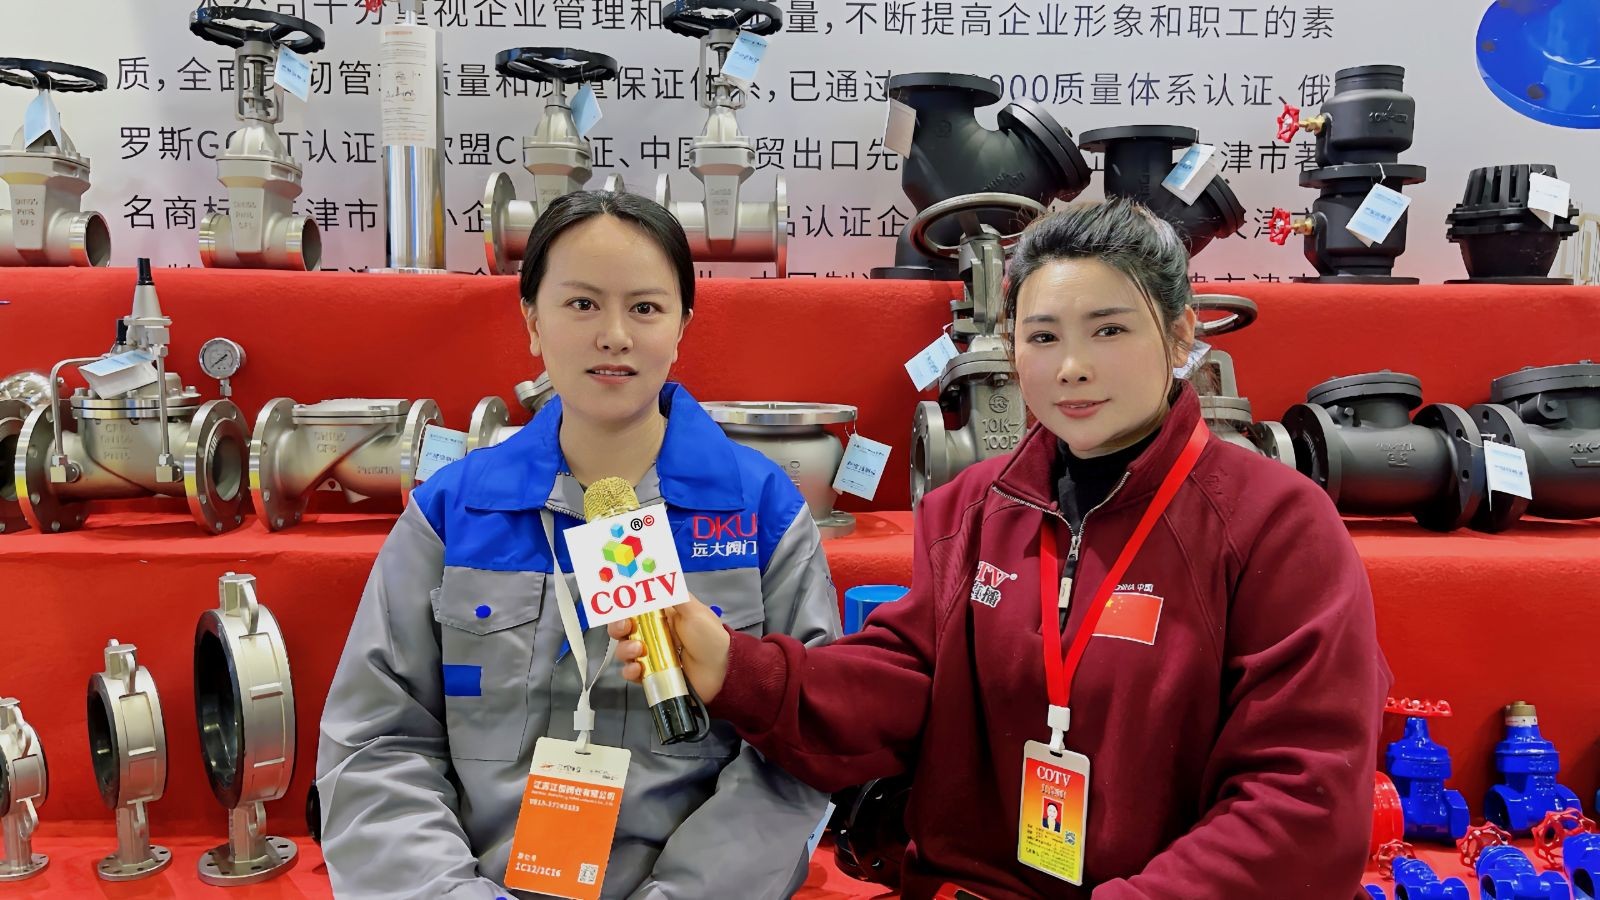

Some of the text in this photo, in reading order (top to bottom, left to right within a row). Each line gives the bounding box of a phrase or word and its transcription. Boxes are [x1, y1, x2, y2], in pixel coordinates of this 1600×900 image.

[692, 513, 758, 541] DKU
[691, 540, 757, 558] 远大阀门
[975, 560, 1011, 589] TV
[590, 571, 677, 616] COTV
[1036, 765, 1071, 788] COTV
